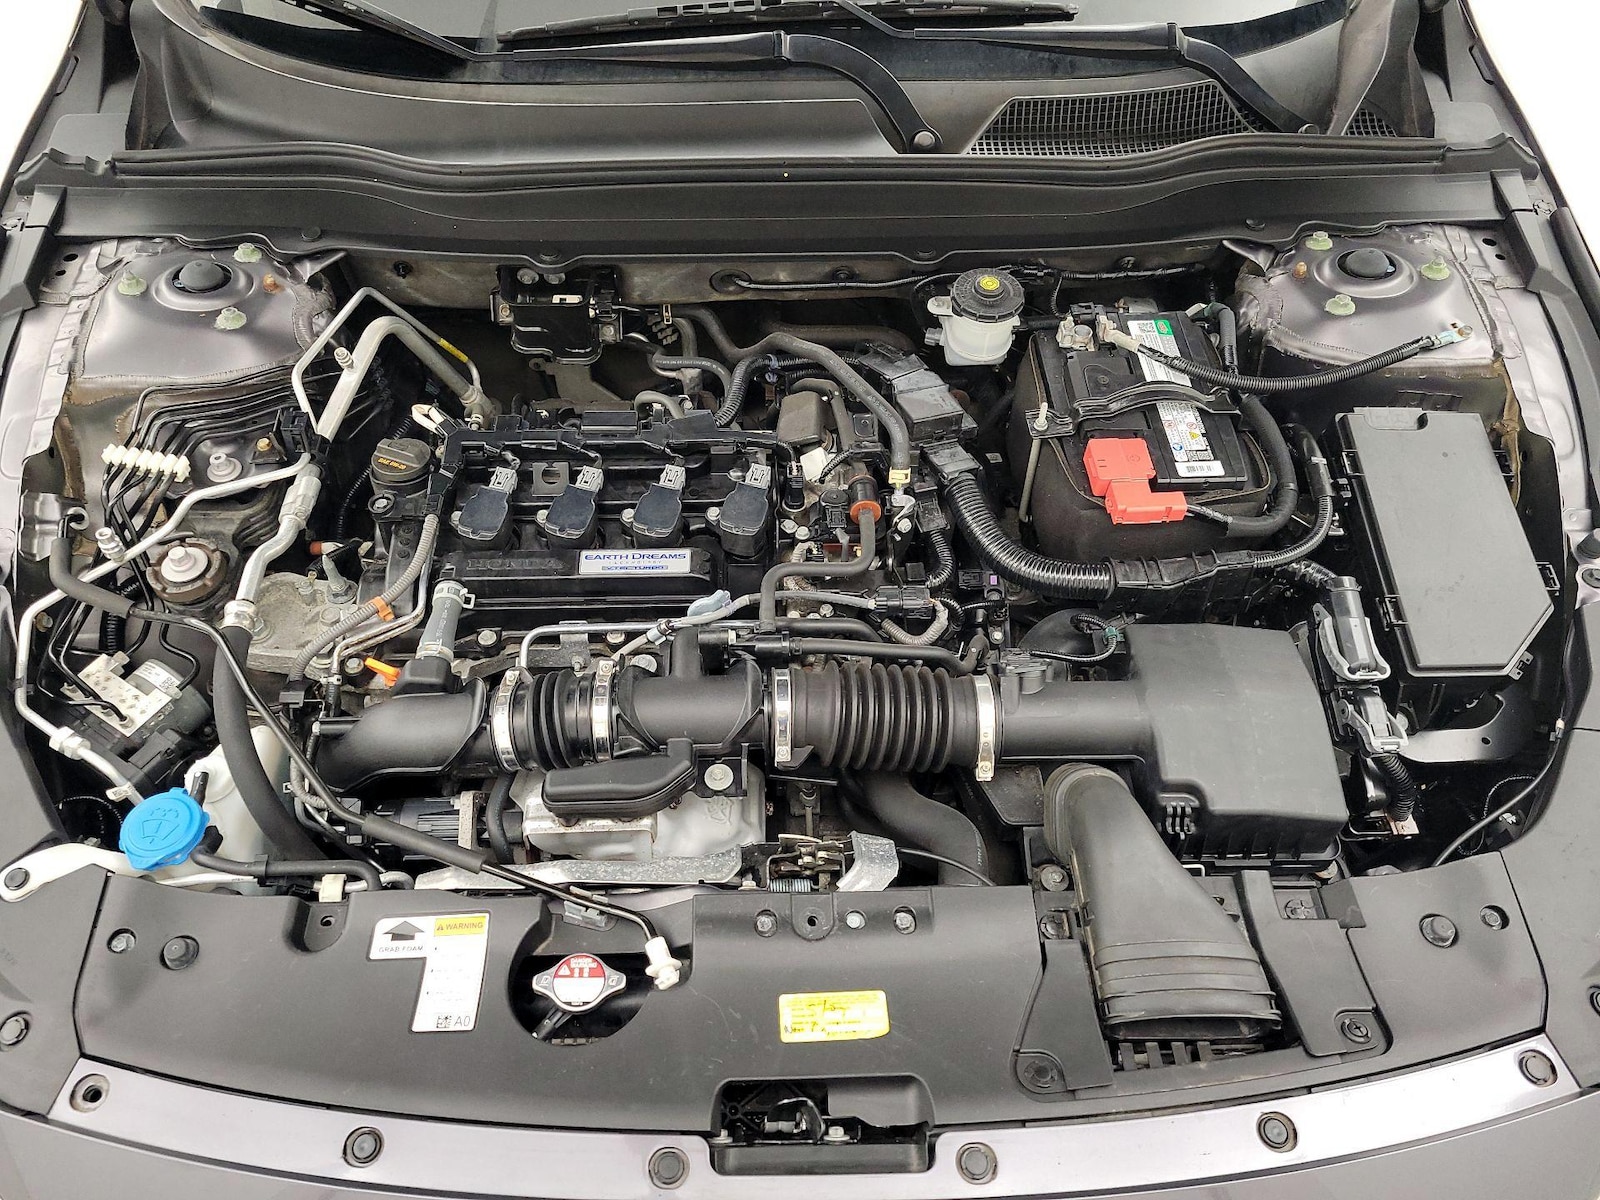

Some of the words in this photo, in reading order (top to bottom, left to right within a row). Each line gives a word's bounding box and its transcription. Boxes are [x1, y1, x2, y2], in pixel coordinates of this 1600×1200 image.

[631, 552, 687, 560] DREAMS
[466, 558, 568, 571] HONDA
[445, 921, 484, 931] WARNING
[378, 945, 400, 953] GRAB
[401, 944, 424, 952] FOAM
